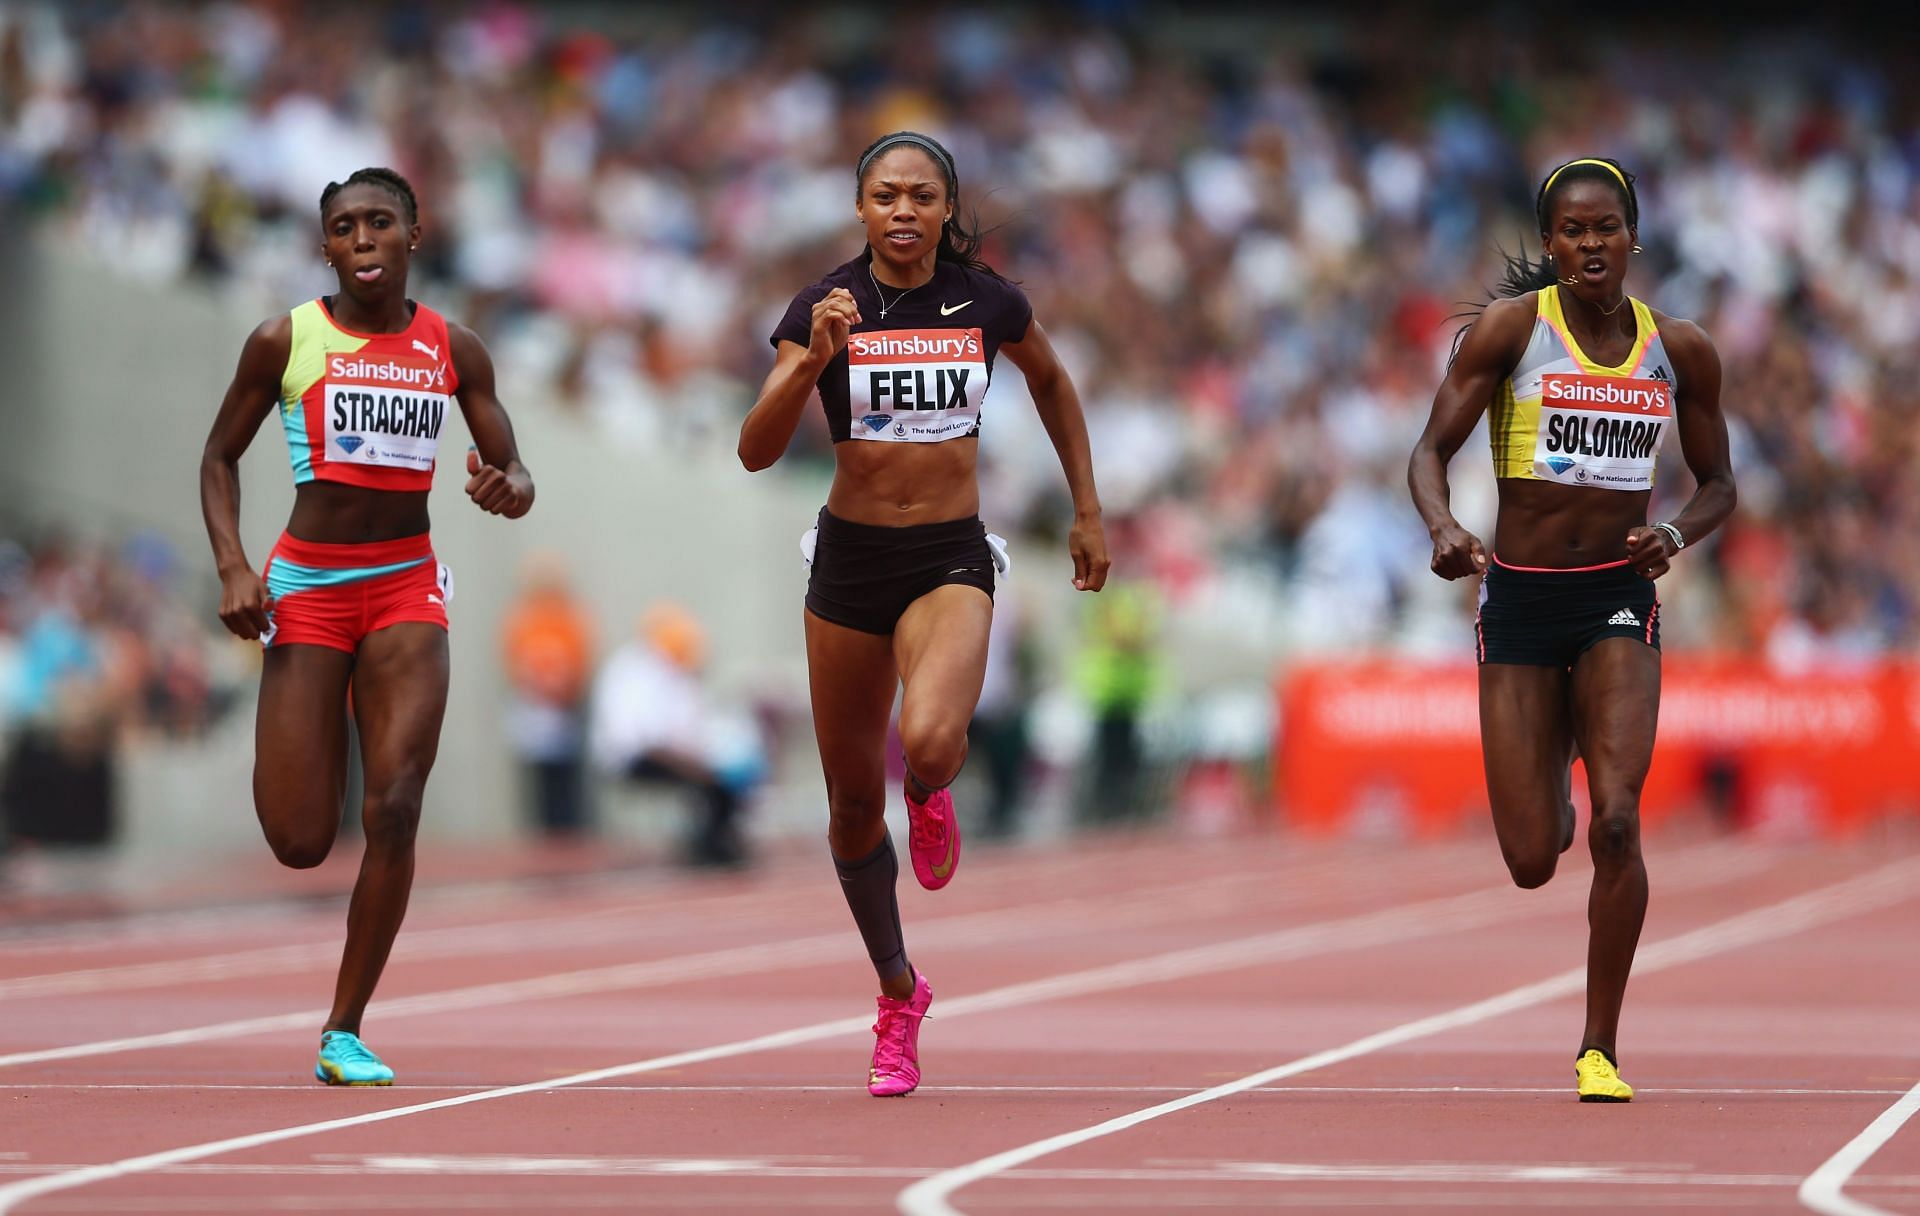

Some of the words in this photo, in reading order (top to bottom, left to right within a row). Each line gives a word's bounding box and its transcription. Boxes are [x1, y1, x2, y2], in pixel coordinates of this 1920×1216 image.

[855, 335, 977, 358] Sainsbury's
[331, 357, 447, 388] Sainsbury's
[870, 368, 970, 411] FELIX
[1548, 379, 1665, 410] Sainsbury's
[333, 391, 444, 440] STRACHAN
[926, 424, 951, 434] National
[1546, 413, 1662, 459] SOLOMON
[1608, 618, 1640, 626] adidas
